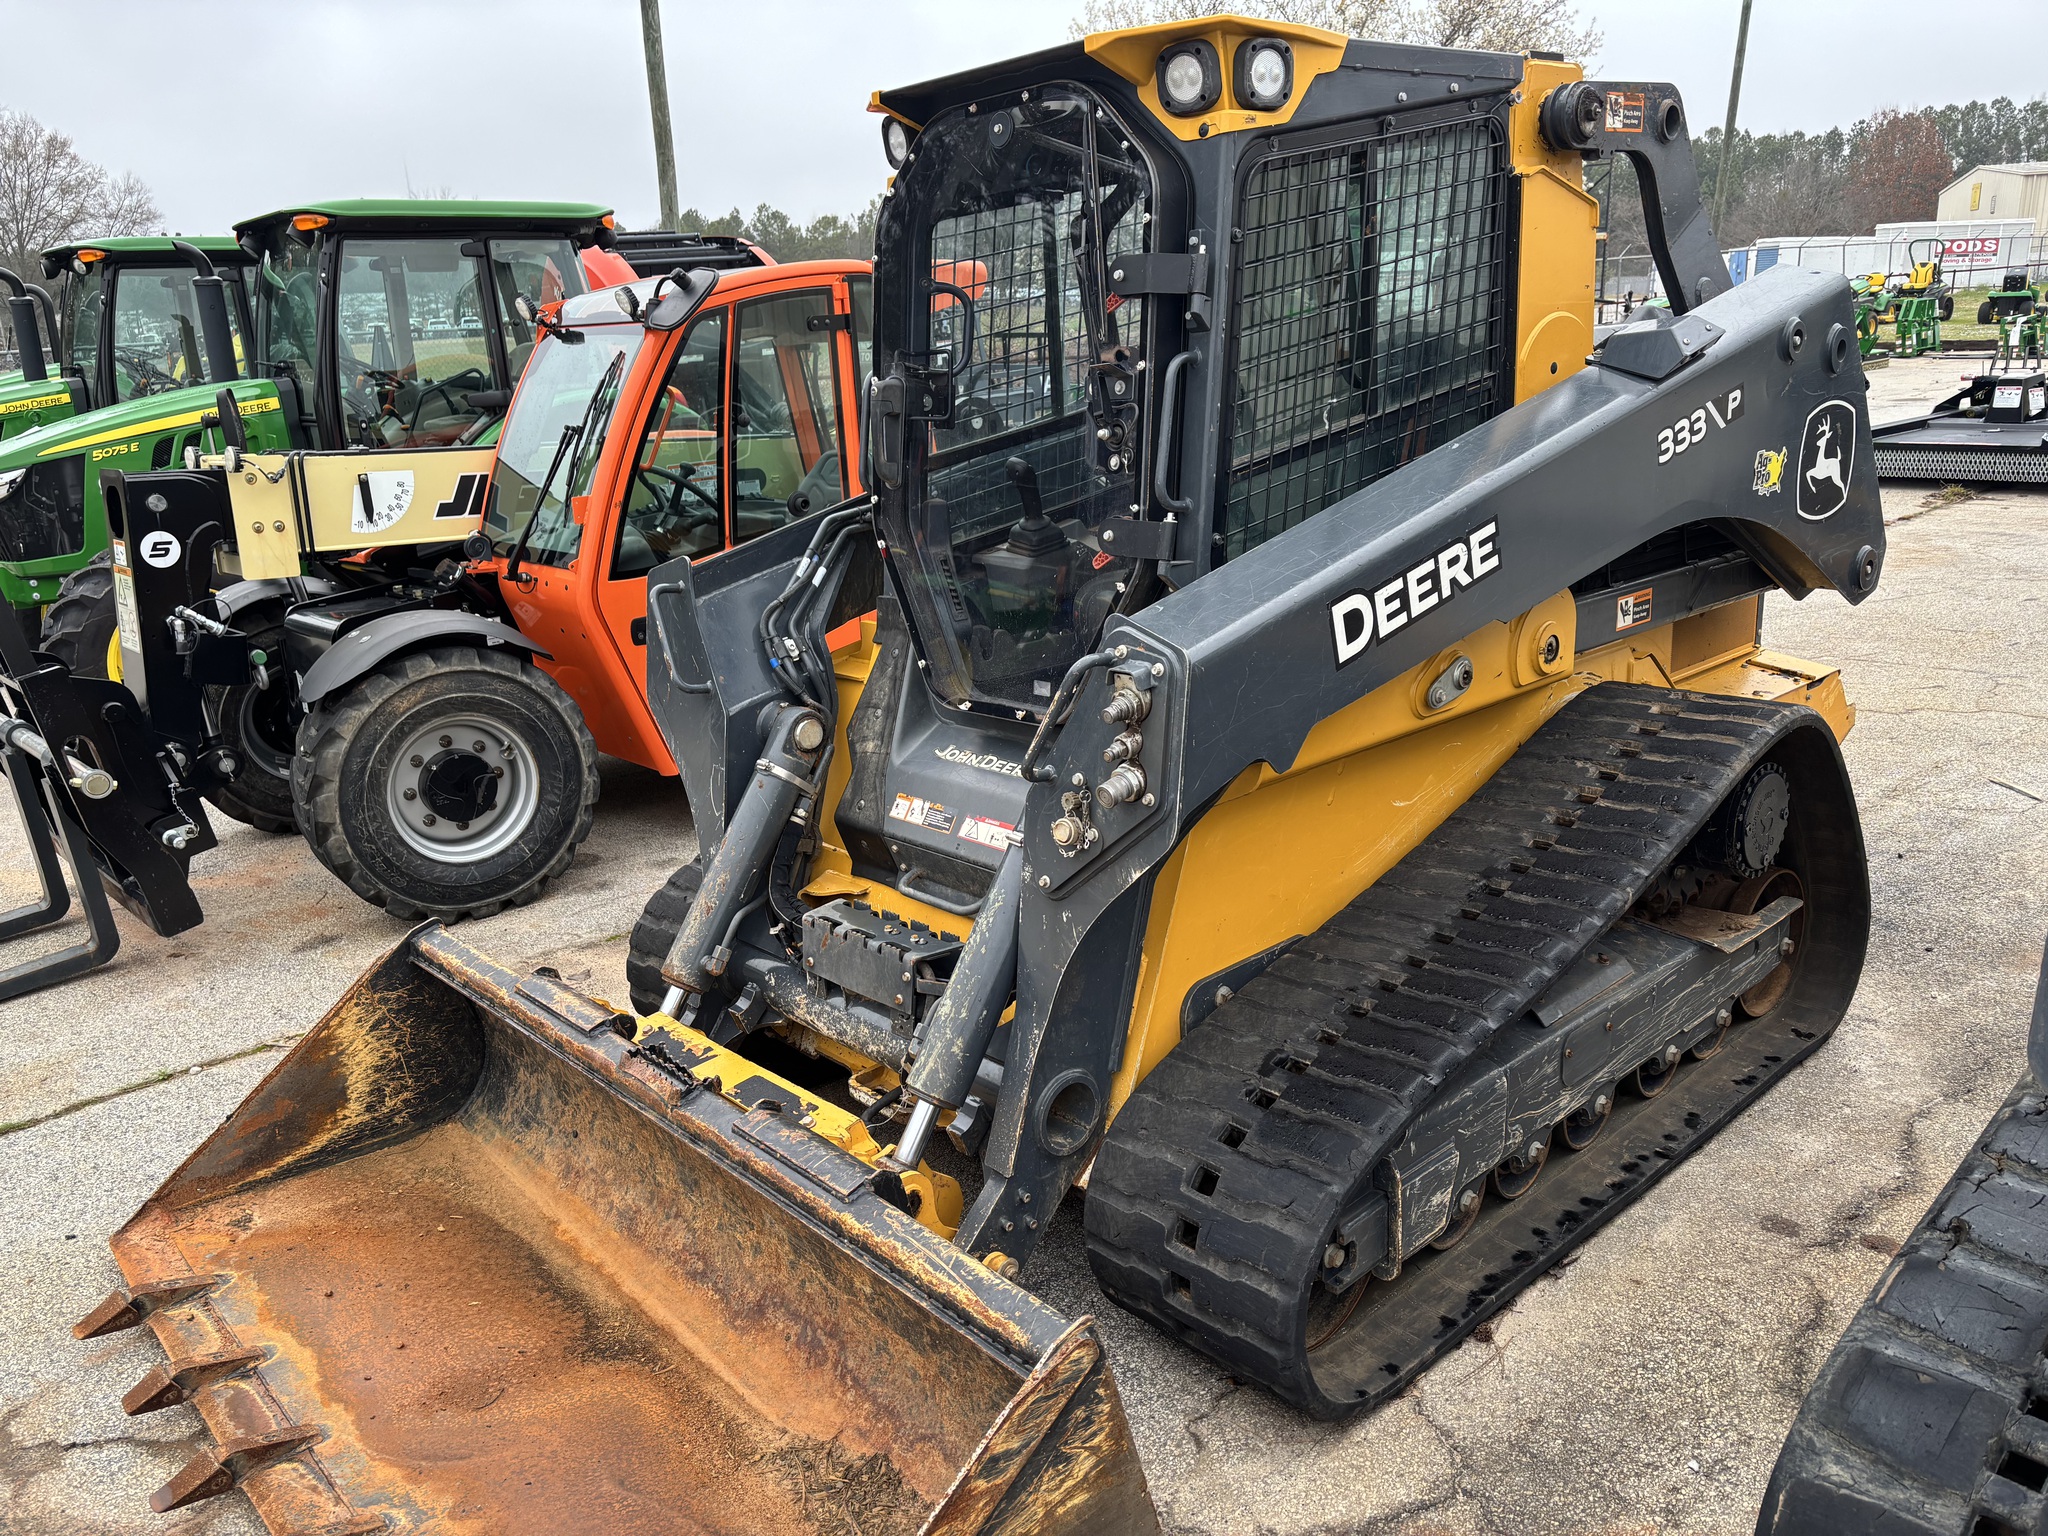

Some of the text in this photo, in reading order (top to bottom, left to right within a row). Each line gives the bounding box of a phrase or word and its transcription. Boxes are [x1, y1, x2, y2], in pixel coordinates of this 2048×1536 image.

[1937, 240, 1997, 252] PODS
[2, 397, 63, 413] JOHN DEERE
[92, 442, 140, 462] 5075 E
[376, 511, 384, 520] 20
[1331, 521, 1500, 665] DEERE
[934, 744, 981, 768] JOHN
